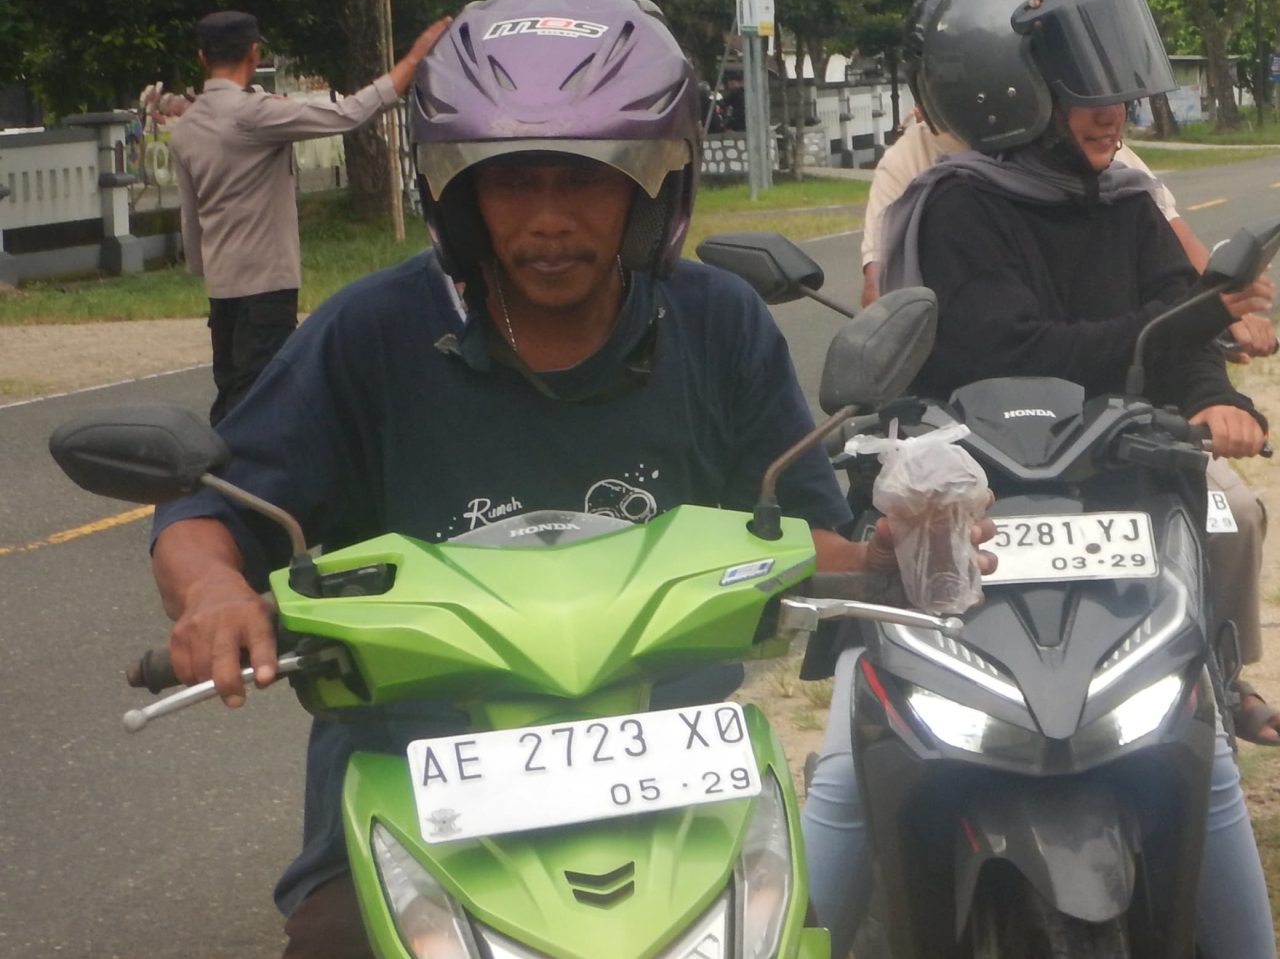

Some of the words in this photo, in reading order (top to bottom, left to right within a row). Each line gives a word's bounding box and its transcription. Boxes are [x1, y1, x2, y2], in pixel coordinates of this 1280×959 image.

[1003, 408, 1057, 419] HONDA
[508, 522, 581, 539] HONDA
[993, 518, 1075, 549] 5281
[1096, 517, 1141, 544] YJ
[422, 739, 483, 787] AE
[518, 718, 649, 773] 2723
